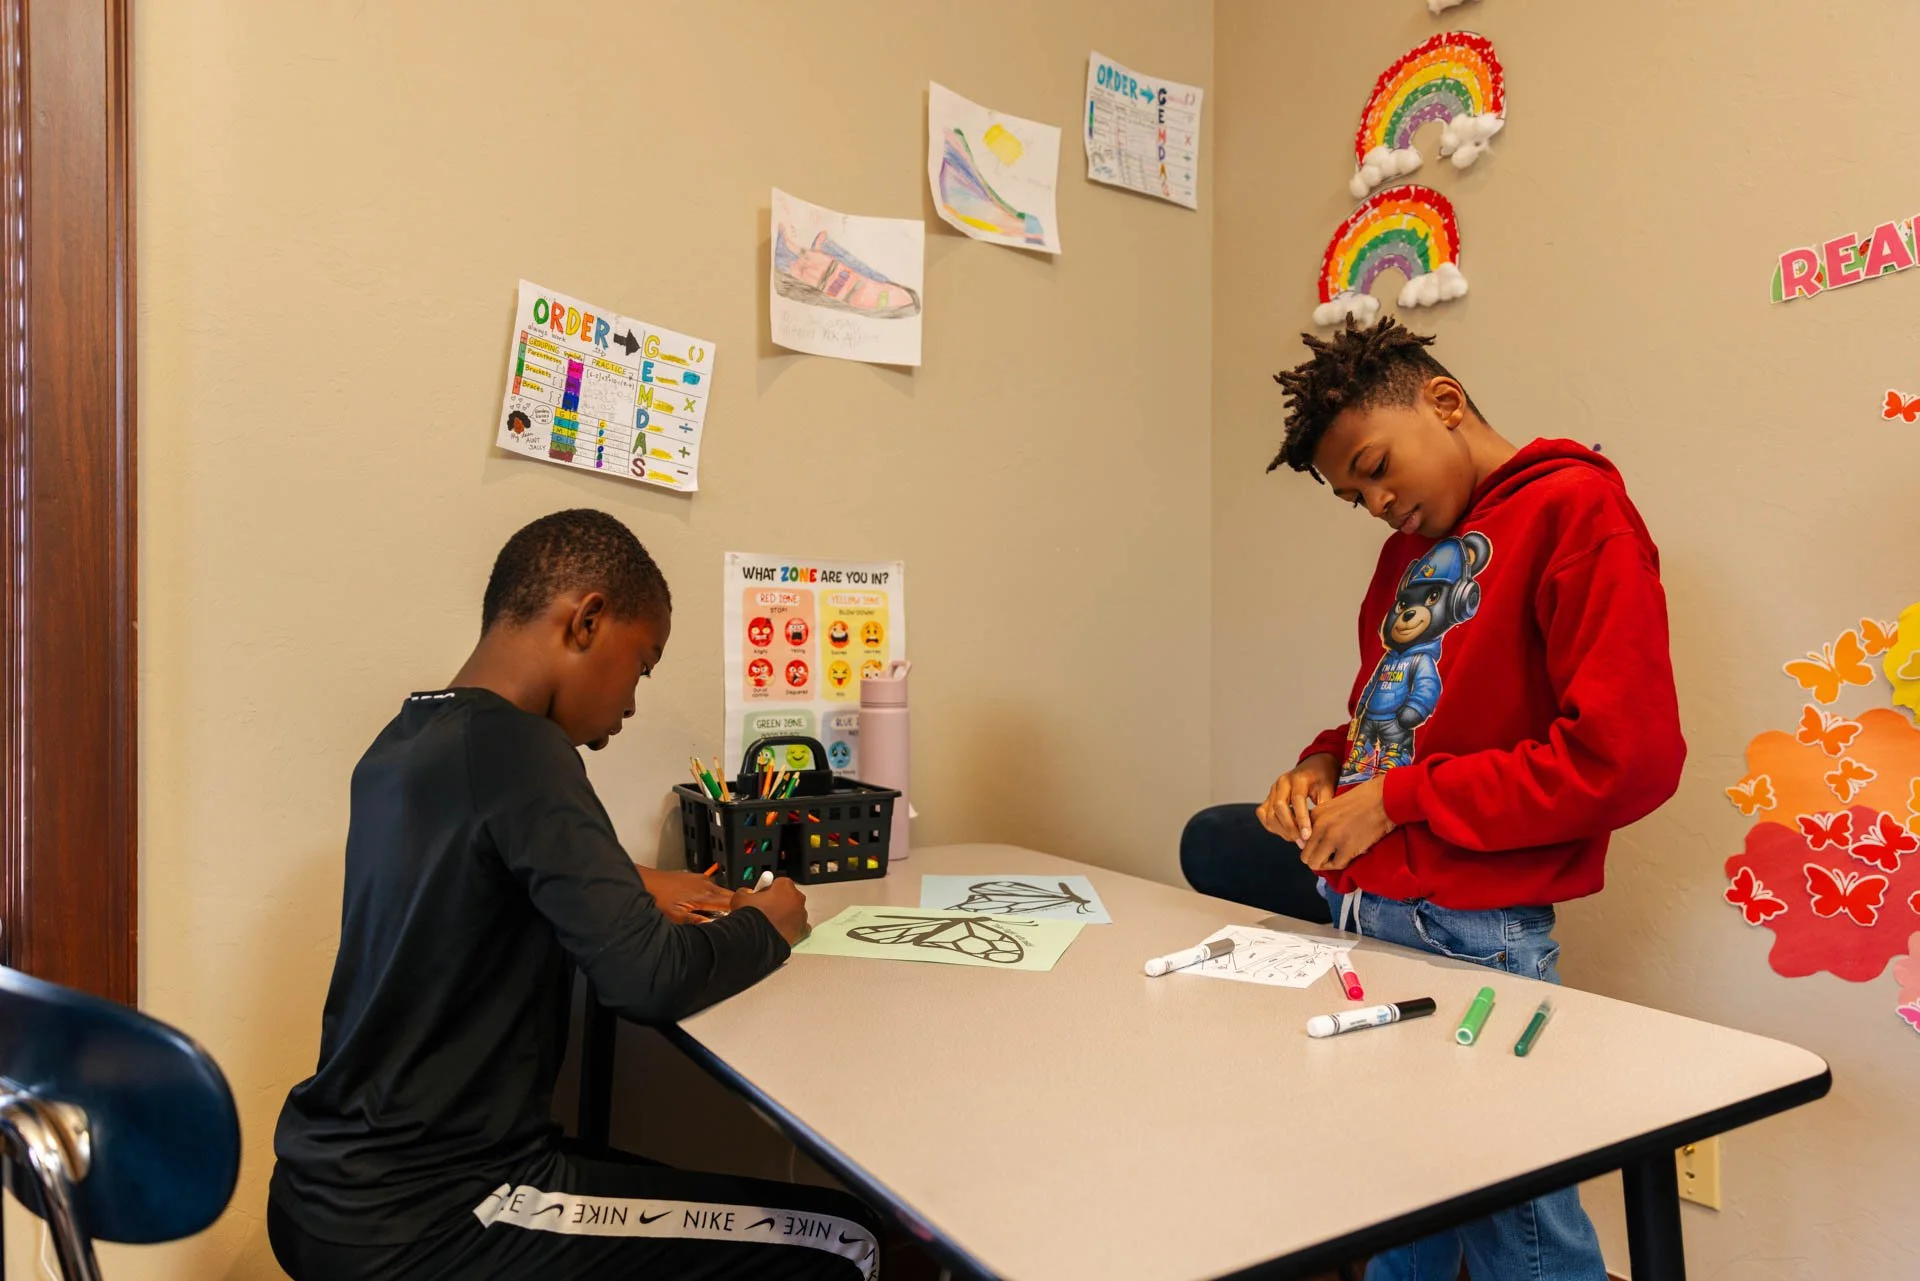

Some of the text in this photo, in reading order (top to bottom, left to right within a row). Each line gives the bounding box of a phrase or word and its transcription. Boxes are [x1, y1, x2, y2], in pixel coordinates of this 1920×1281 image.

[1097, 64, 1137, 100] ORDER
[1779, 214, 1920, 300] REA
[533, 298, 610, 350] ORDER
[529, 337, 560, 354] GROUPING
[592, 358, 626, 376] PRACTICE
[522, 380, 543, 392] Braces
[743, 566, 889, 584] WHAT ZONE ARE YOU IN?
[761, 593, 775, 603] RED
[1378, 671, 1404, 682] AUTISM
[756, 719, 804, 729] GREEN ZONE
[572, 1203, 628, 1225] NIKE
[683, 1210, 735, 1231] NIKE
[783, 1216, 832, 1240] NIKE
